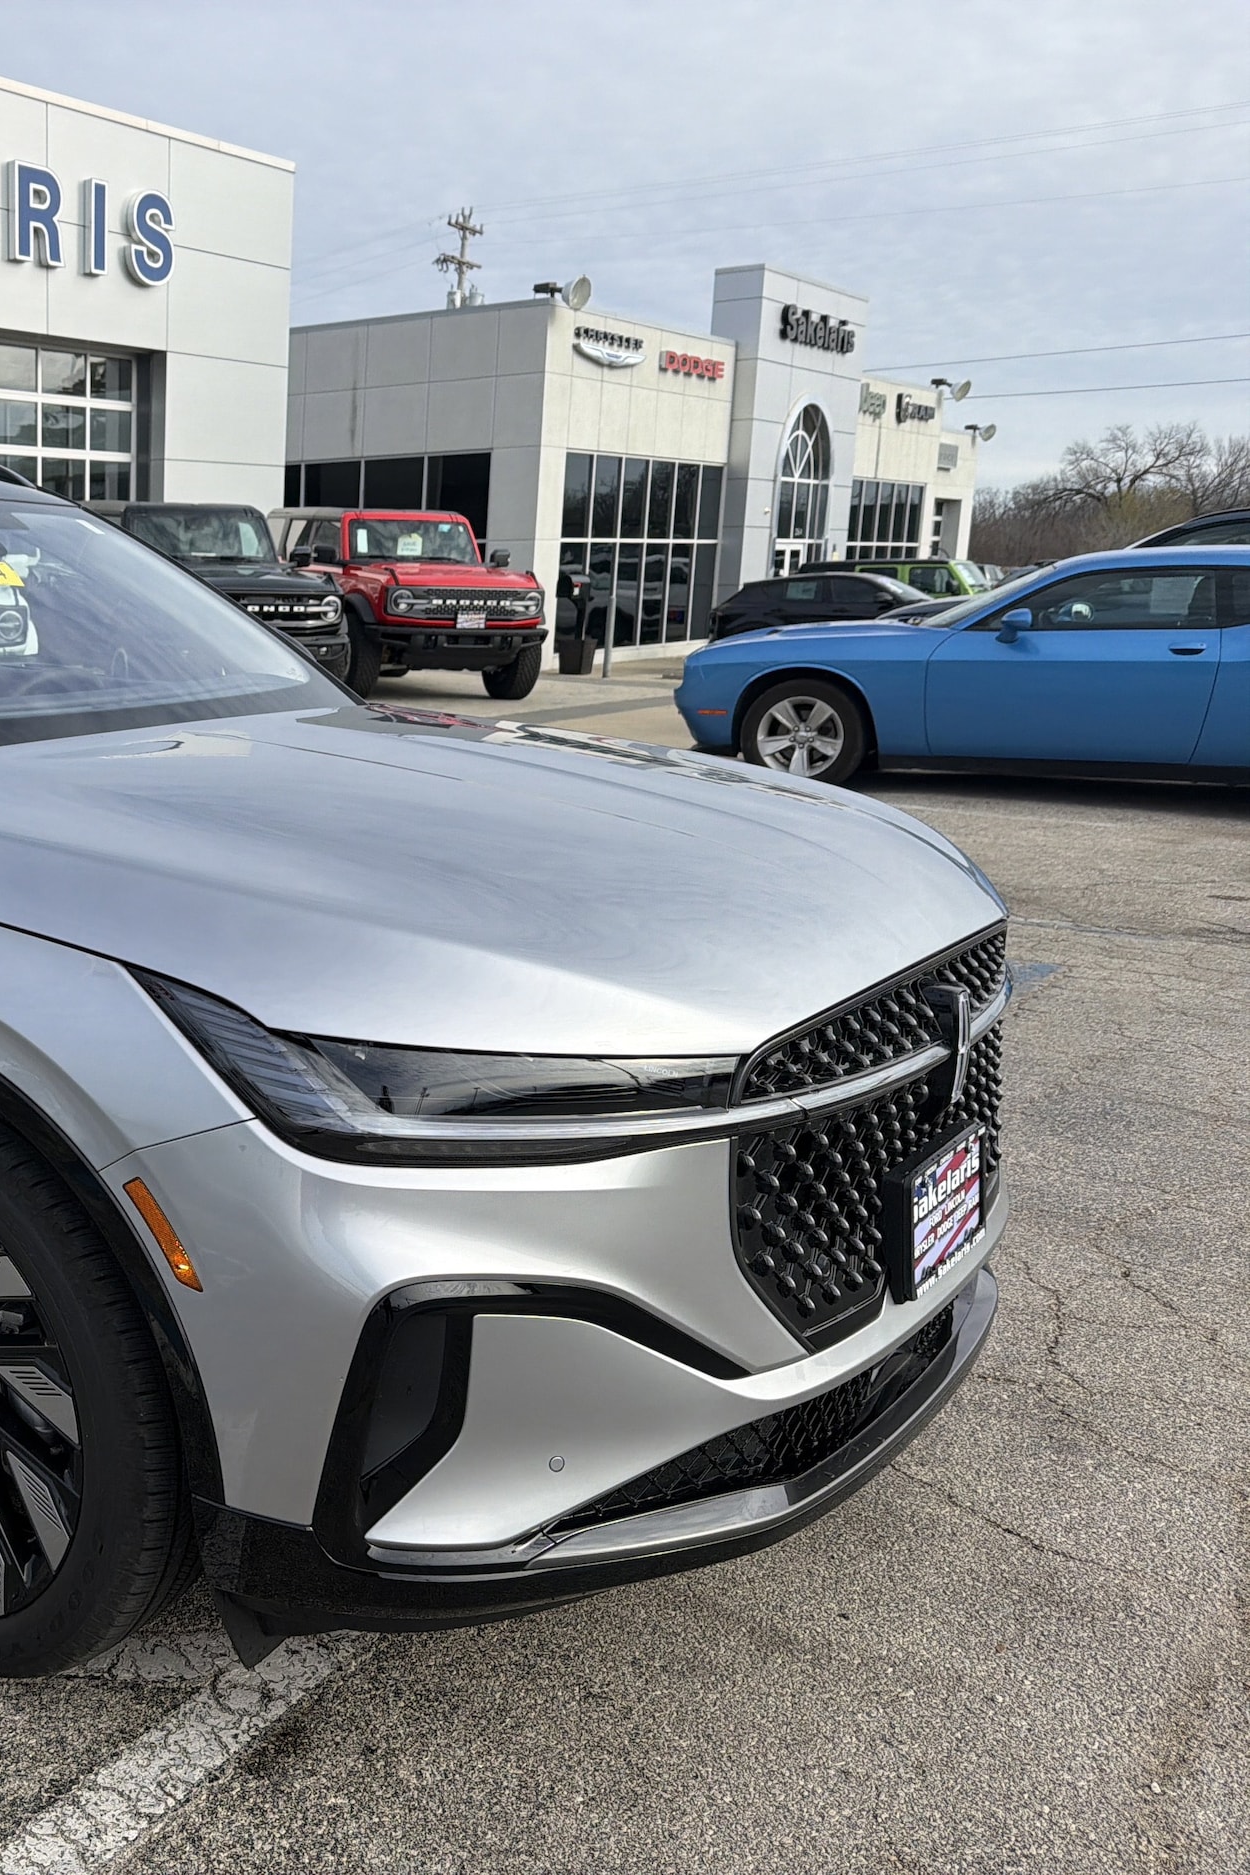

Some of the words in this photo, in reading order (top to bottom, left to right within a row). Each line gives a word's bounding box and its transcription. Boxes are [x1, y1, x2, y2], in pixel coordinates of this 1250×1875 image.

[780, 304, 855, 354] Sakelaris
[661, 350, 725, 381] DODGE
[247, 605, 305, 613] ONCO
[944, 1189, 966, 1215] LINCOLN
